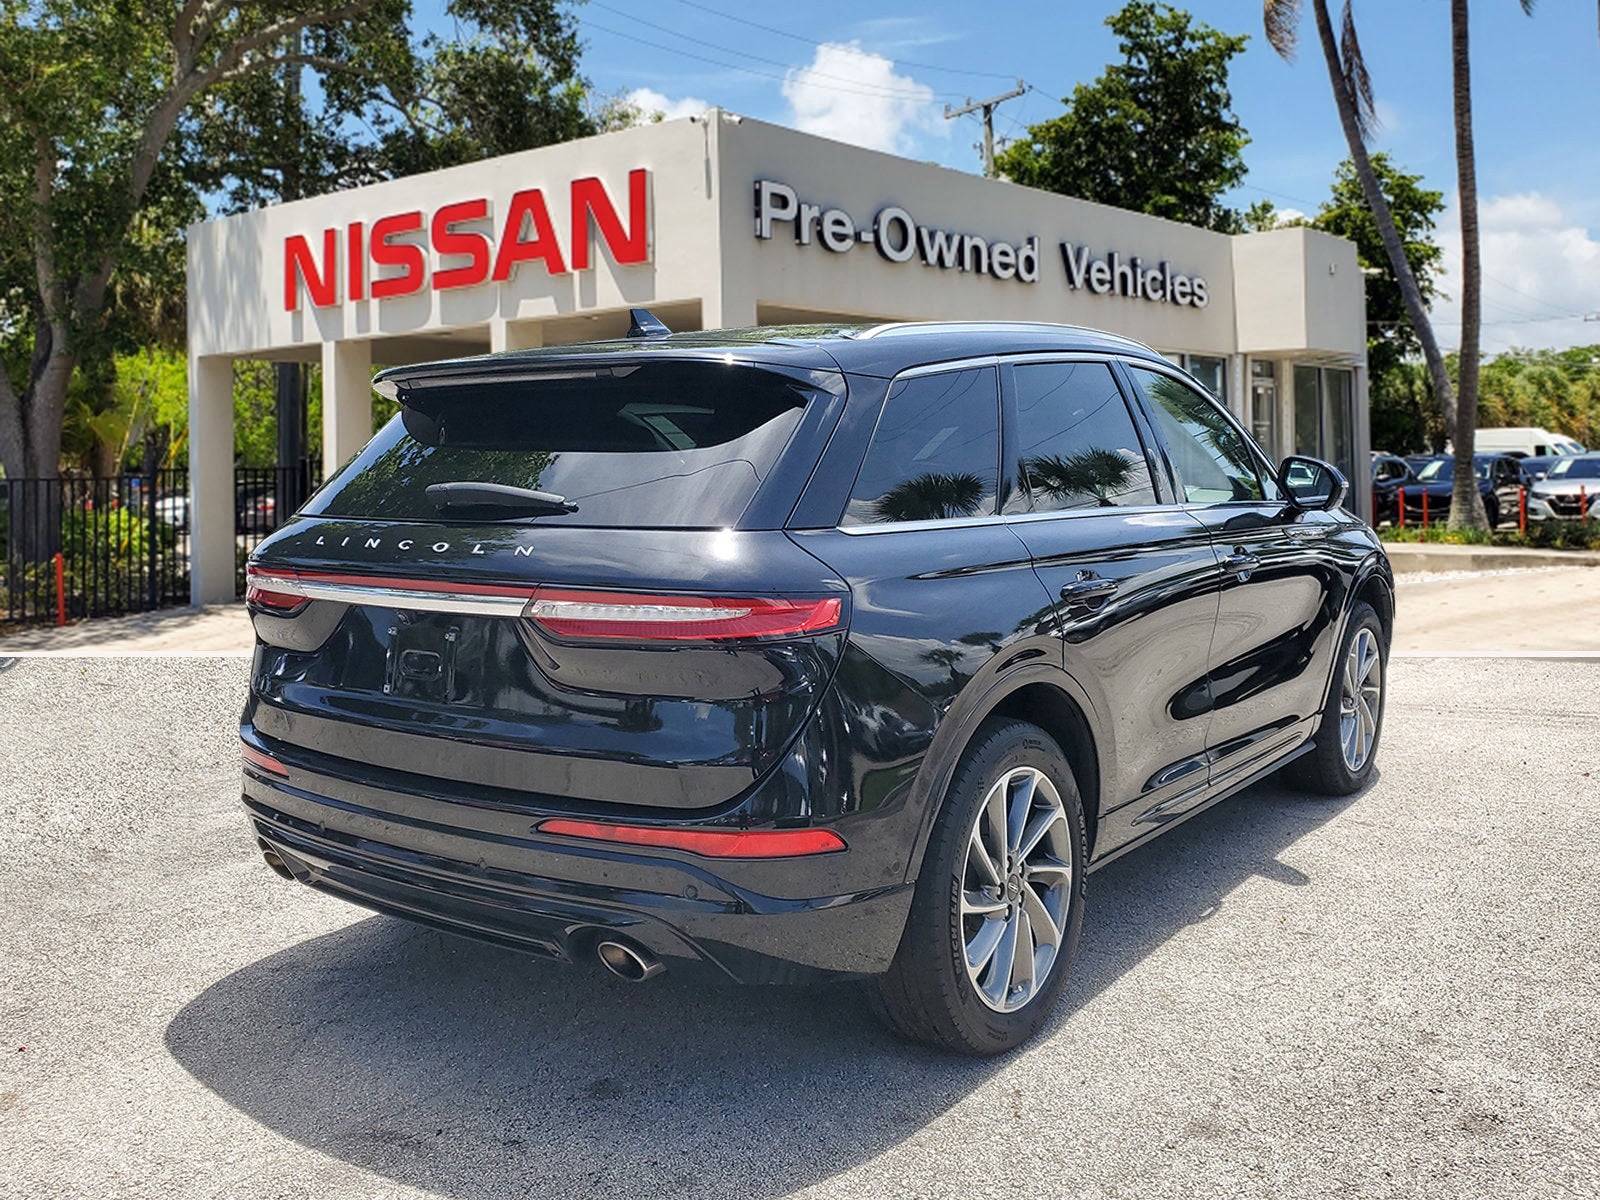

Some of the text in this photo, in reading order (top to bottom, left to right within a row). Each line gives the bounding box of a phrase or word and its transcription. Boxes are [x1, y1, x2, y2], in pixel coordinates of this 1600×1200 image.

[284, 168, 648, 313] NISSAN
[754, 179, 1209, 309] Pre-Owned Vehicles
[315, 536, 535, 557] LINCOLN
[950, 880, 962, 976] MICHELIN
